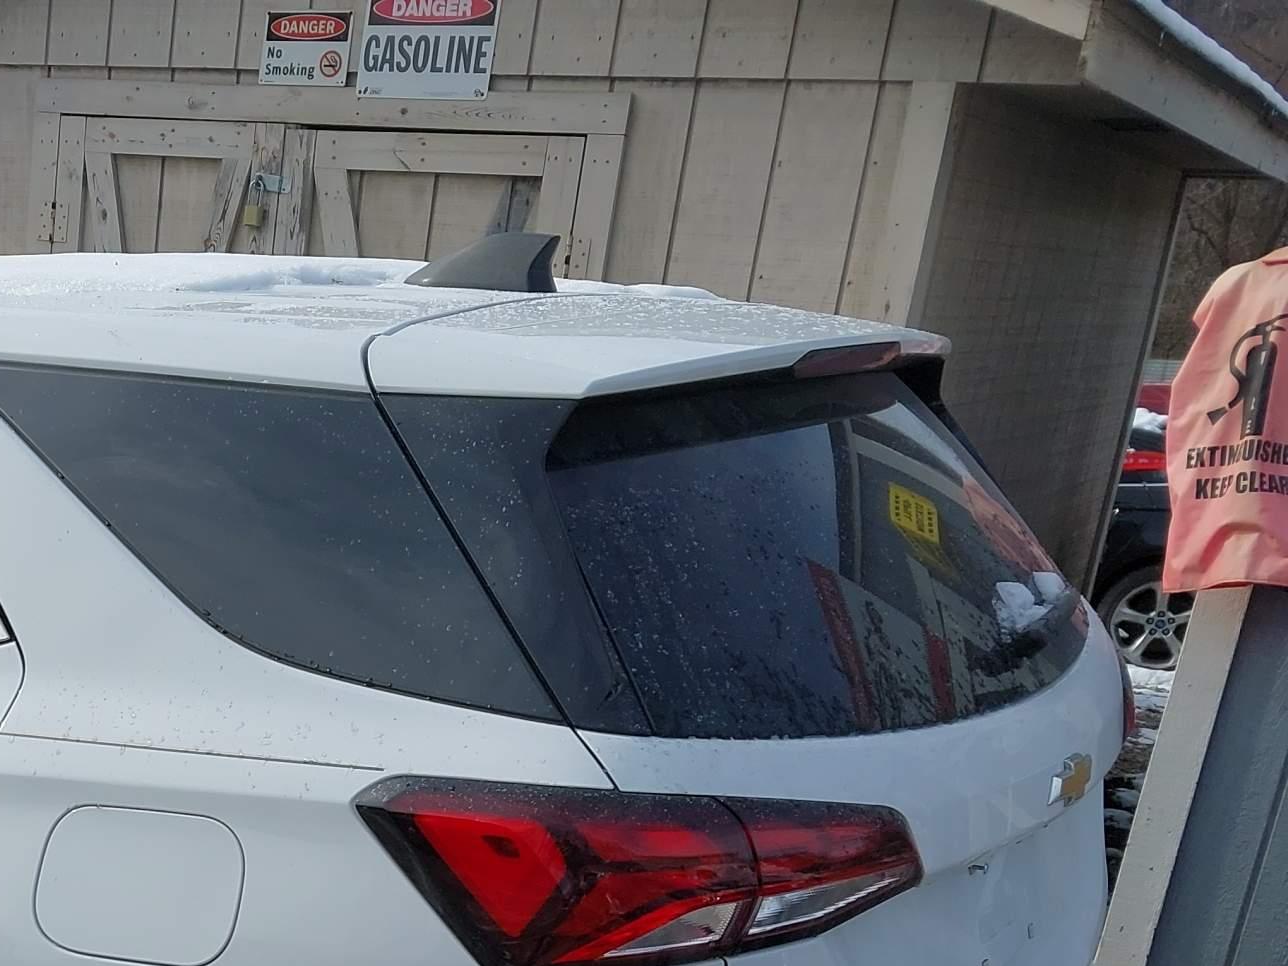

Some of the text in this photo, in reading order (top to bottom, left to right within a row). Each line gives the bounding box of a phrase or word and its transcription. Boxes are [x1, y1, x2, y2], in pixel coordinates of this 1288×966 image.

[392, 0, 472, 17] DANGER
[280, 20, 336, 34] DANGER
[267, 46, 282, 59] No
[363, 34, 491, 73] GASOLINE
[264, 62, 315, 80] Smoking
